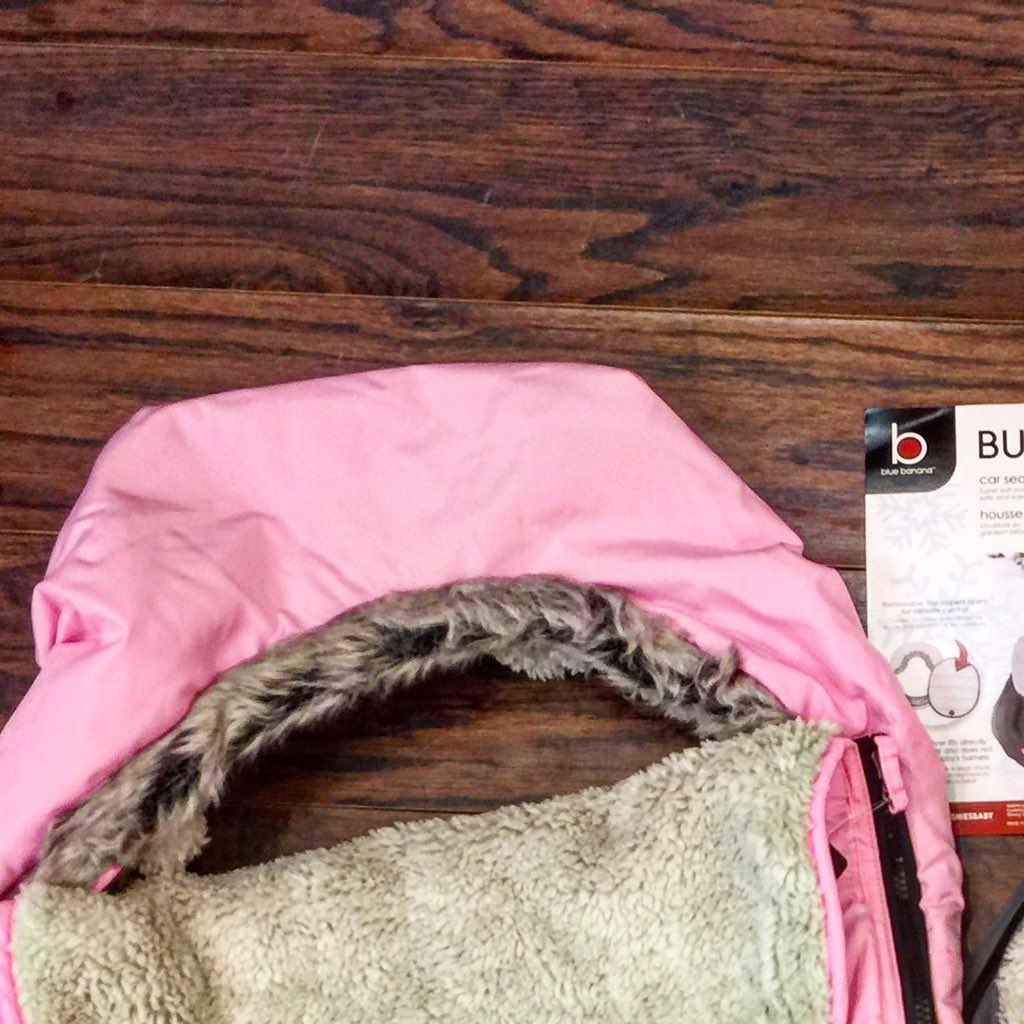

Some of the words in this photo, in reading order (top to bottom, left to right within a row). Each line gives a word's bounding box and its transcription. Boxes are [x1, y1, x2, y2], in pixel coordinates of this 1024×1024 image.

[891, 422, 928, 465] b
[880, 468, 899, 476] blue
[979, 475, 1000, 485] car
[980, 509, 1023, 520] housse
